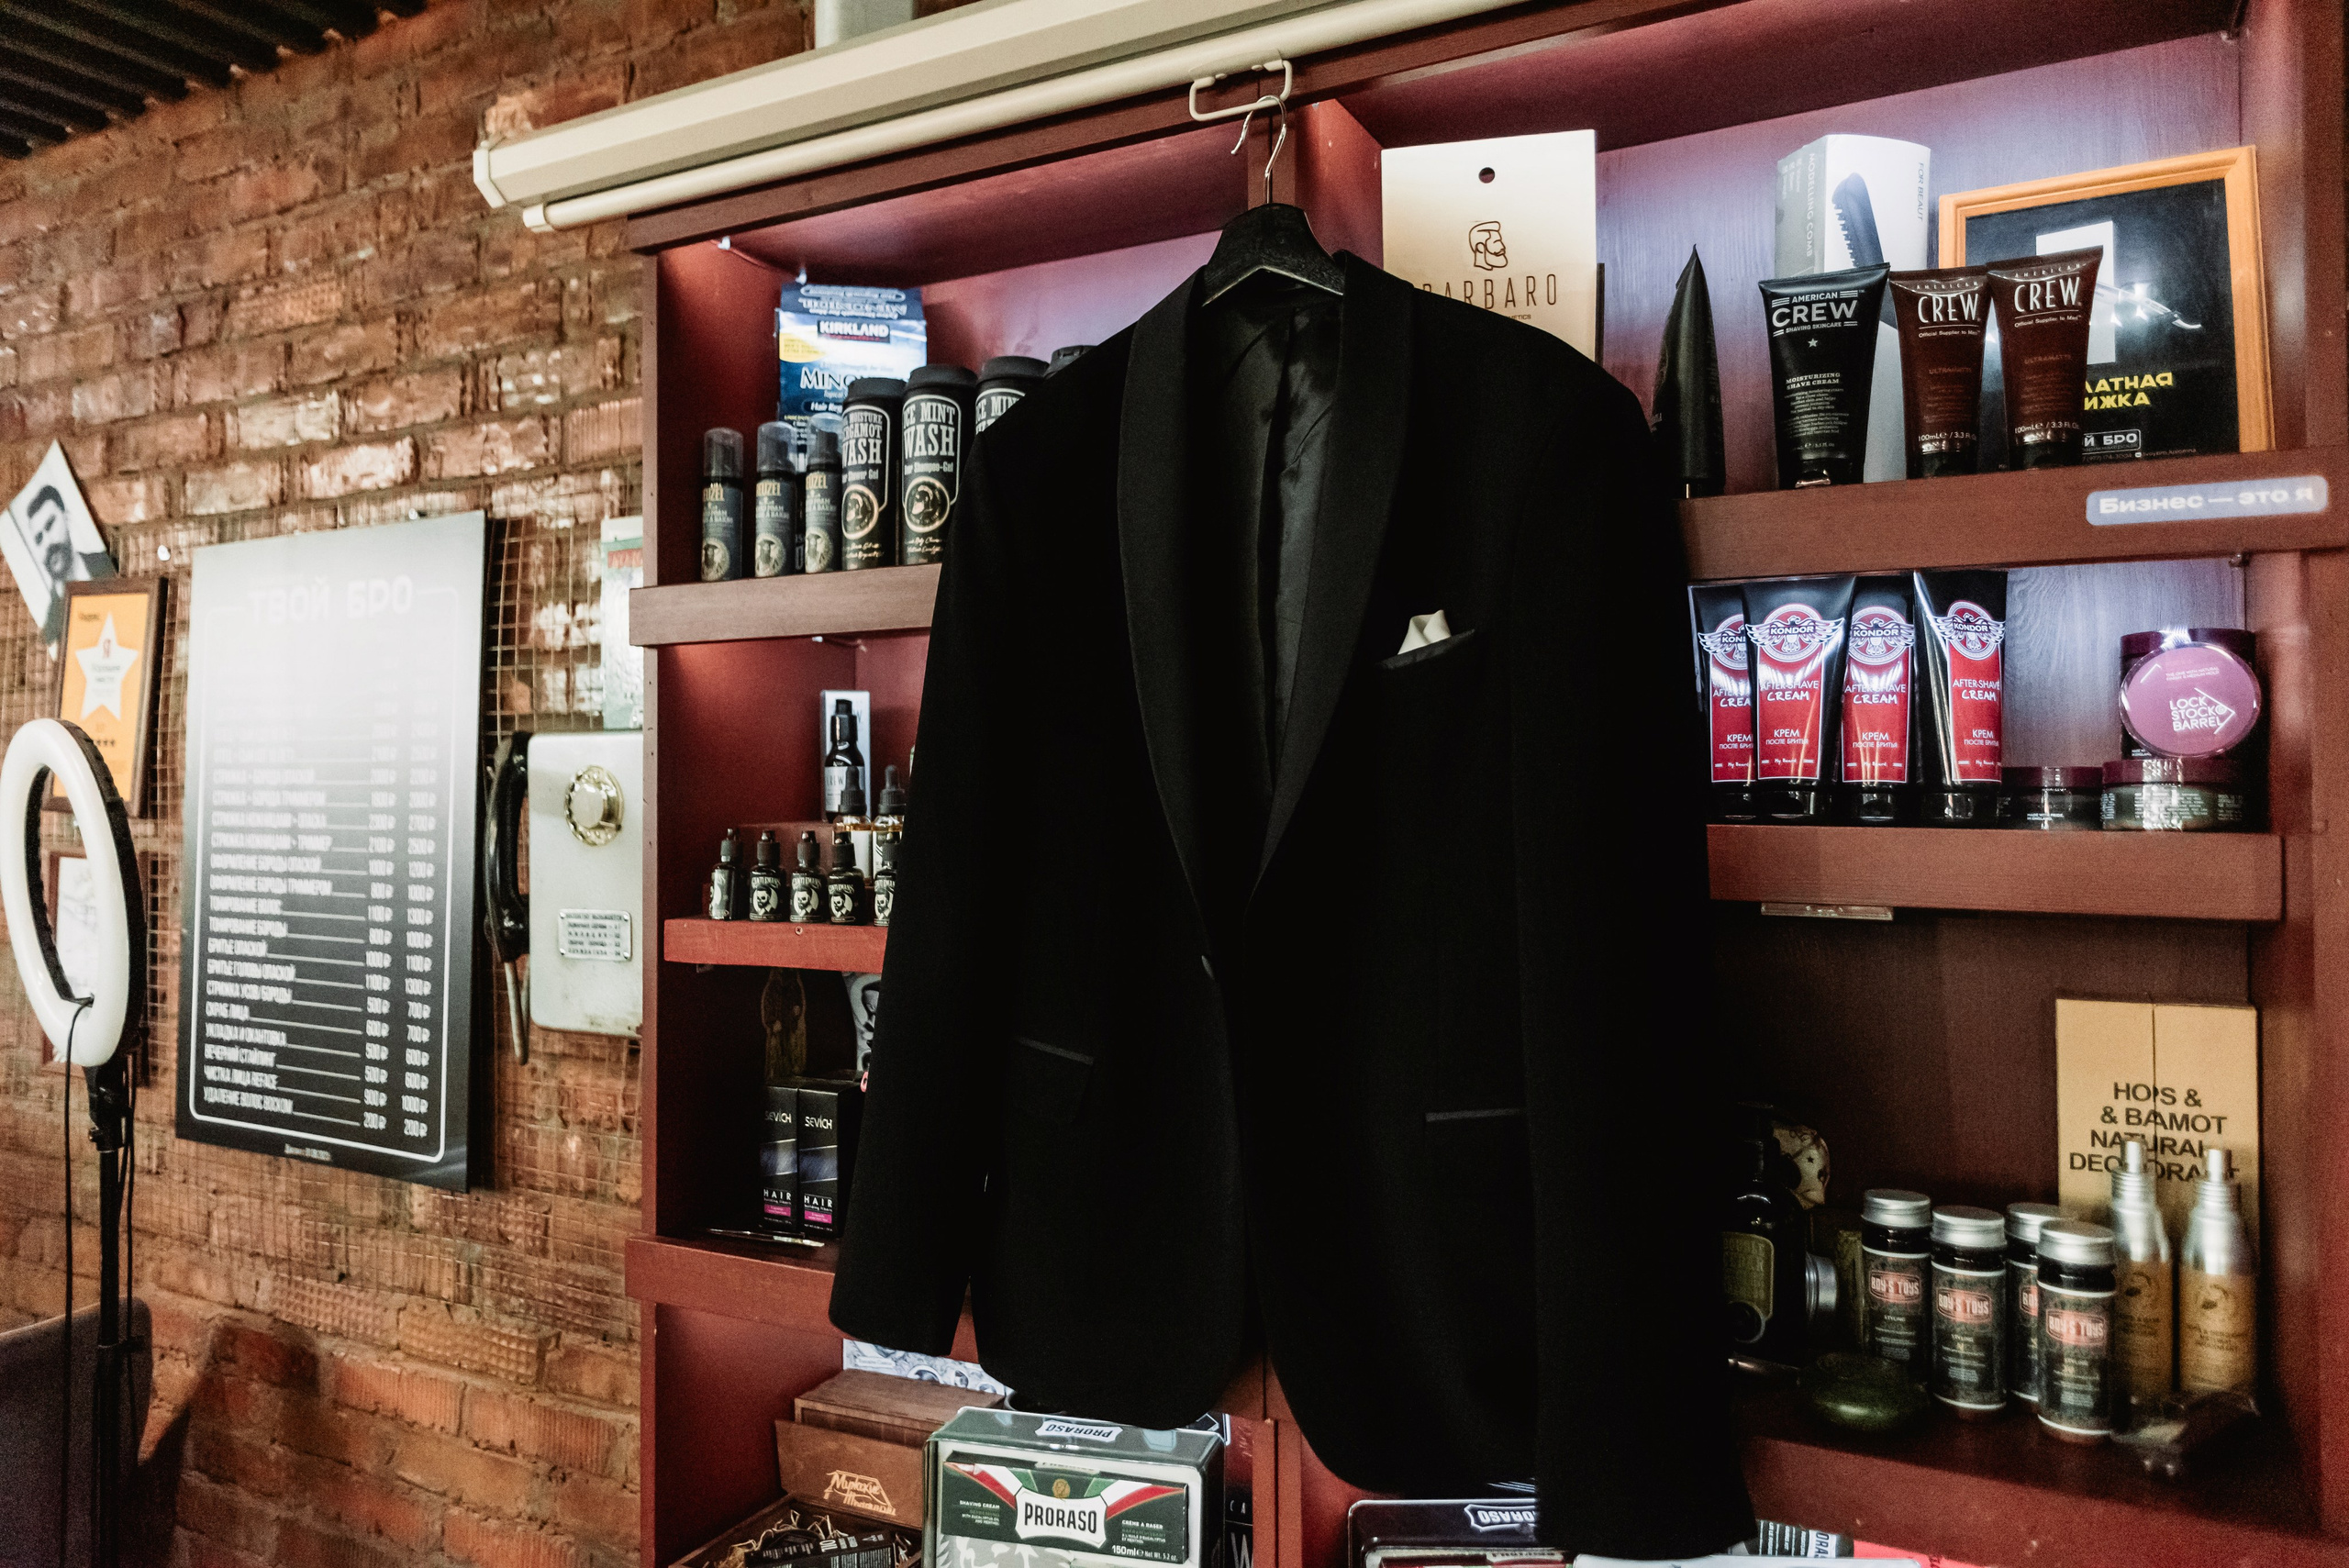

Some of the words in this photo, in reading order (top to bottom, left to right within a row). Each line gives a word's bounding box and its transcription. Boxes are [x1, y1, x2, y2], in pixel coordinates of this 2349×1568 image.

[1917, 161, 1925, 184] FOR
[1806, 222, 1814, 258] COMB
[2014, 263, 2081, 278] AMERICAN
[1916, 281, 1978, 290] AMERICAN
[1791, 291, 1838, 304] AMERICAN
[2014, 276, 2080, 313] CREW
[1772, 300, 1857, 328] CREW
[1918, 293, 1979, 324] CREW
[819, 321, 890, 338] KIRKLAND
[1786, 324, 1811, 333] SHAVING
[1811, 321, 1842, 330] SKINCARE
[2014, 318, 2034, 328] Official
[2035, 316, 2058, 324] Supplier
[1919, 330, 1938, 339] Official
[1786, 372, 1841, 384] MOISTURIZING
[1786, 380, 1810, 390] SHAVE
[2084, 391, 2152, 411] ИЖКА
[919, 402, 955, 425] MINT
[904, 423, 955, 460] WASH
[2103, 432, 2138, 447] БРО
[2099, 495, 2204, 514] Бизнес
[2238, 490, 2289, 506] это
[248, 576, 330, 624] ТВОЙ
[347, 574, 413, 619] БРО
[1770, 626, 1815, 635] KONDOR
[1853, 628, 1900, 637] KONDOR
[1954, 621, 1989, 632] KONDOR
[1720, 696, 1752, 707] CREA
[1766, 691, 1810, 702] CREAM
[1853, 694, 1898, 705] CREAM
[1961, 689, 1997, 702] CREAM
[2169, 695, 2209, 711] LOCK
[2171, 705, 2216, 722] STOCK
[2172, 715, 2223, 732] BARREL
[1727, 733, 1752, 742] КРЕМ
[1774, 728, 1800, 738] КРЕМ
[1862, 731, 1889, 741] КРЕМ
[1972, 728, 1994, 740] КРЕМ
[1964, 738, 1985, 746] ПОСЛЕ
[2184, 1088, 2202, 1107] &
[805, 1114, 833, 1129] SEVICH
[2100, 1106, 2118, 1125] &
[763, 1188, 792, 1201] HAIR
[804, 1195, 833, 1208] HAIR
[1898, 1281, 1920, 1296] TOYS
[1965, 1298, 1989, 1315] TOYS
[2080, 1320, 2105, 1339] TOYS
[1044, 1423, 1114, 1439] PRORASO
[960, 1499, 982, 1507] SHAVING
[982, 1501, 1000, 1509] CREAM
[1024, 1502, 1097, 1534] PRORASO
[1476, 1510, 1535, 1524] ORASO
